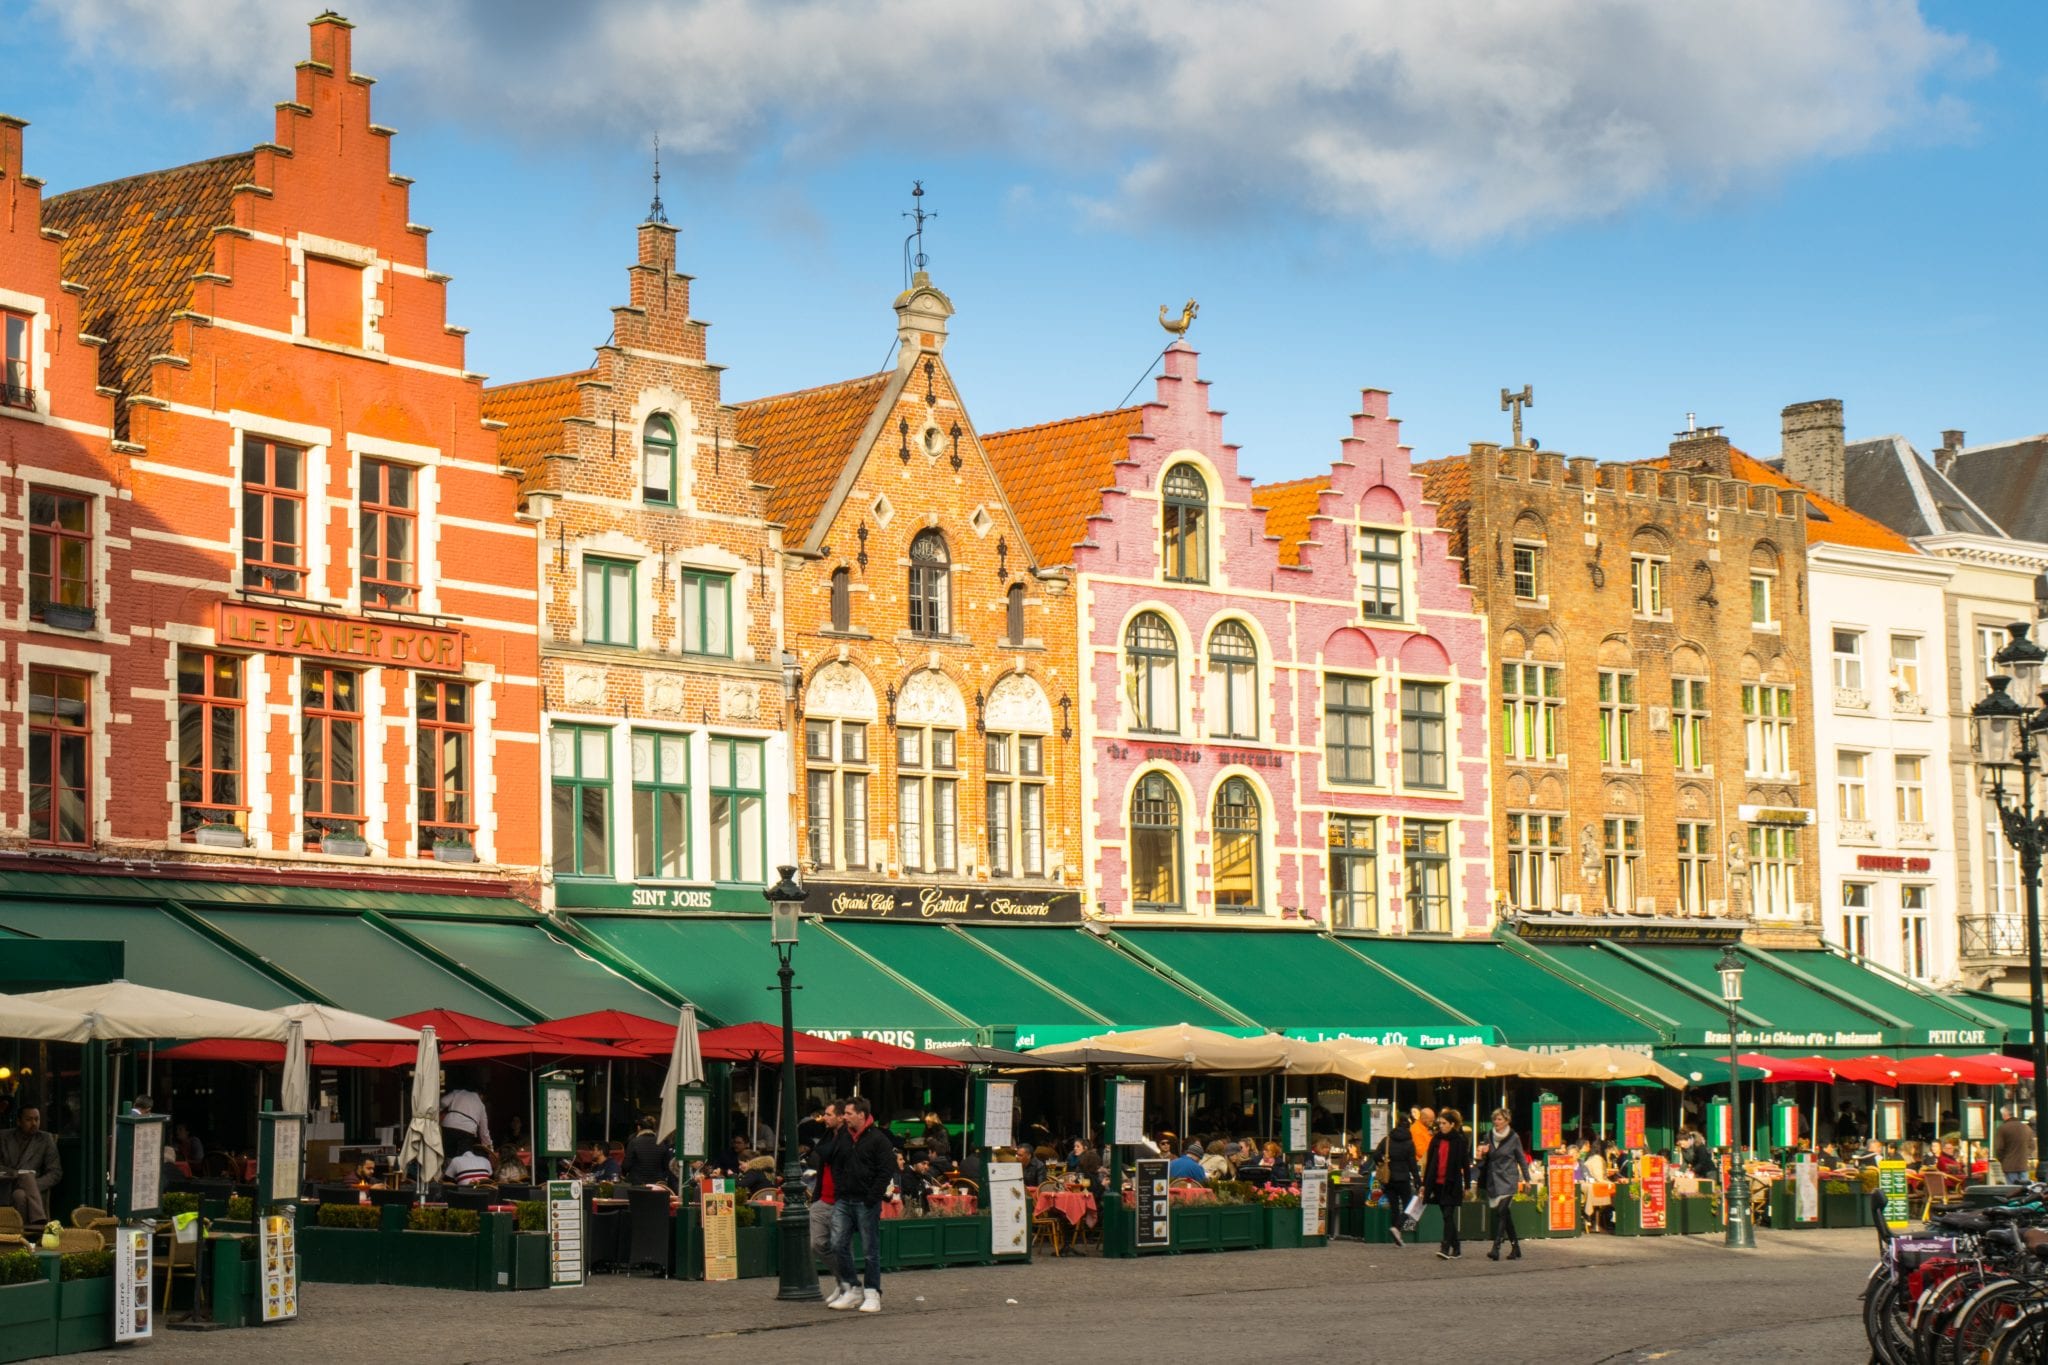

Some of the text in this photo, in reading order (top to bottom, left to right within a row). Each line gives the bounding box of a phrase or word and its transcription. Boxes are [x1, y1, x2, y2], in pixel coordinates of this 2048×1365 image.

[228, 615, 270, 644] LE
[275, 614, 384, 658] PANIER
[632, 889, 712, 908] SINT JORIS
[831, 892, 869, 915] Grand
[919, 888, 968, 917] Central
[990, 897, 1050, 916] Brasserie
[1420, 1033, 1483, 1046] Pizza & pasta
[1704, 1030, 1753, 1044] Brassrie
[1835, 1031, 1882, 1046] Restaurant
[1928, 1030, 1985, 1044] PETIT CAFE
